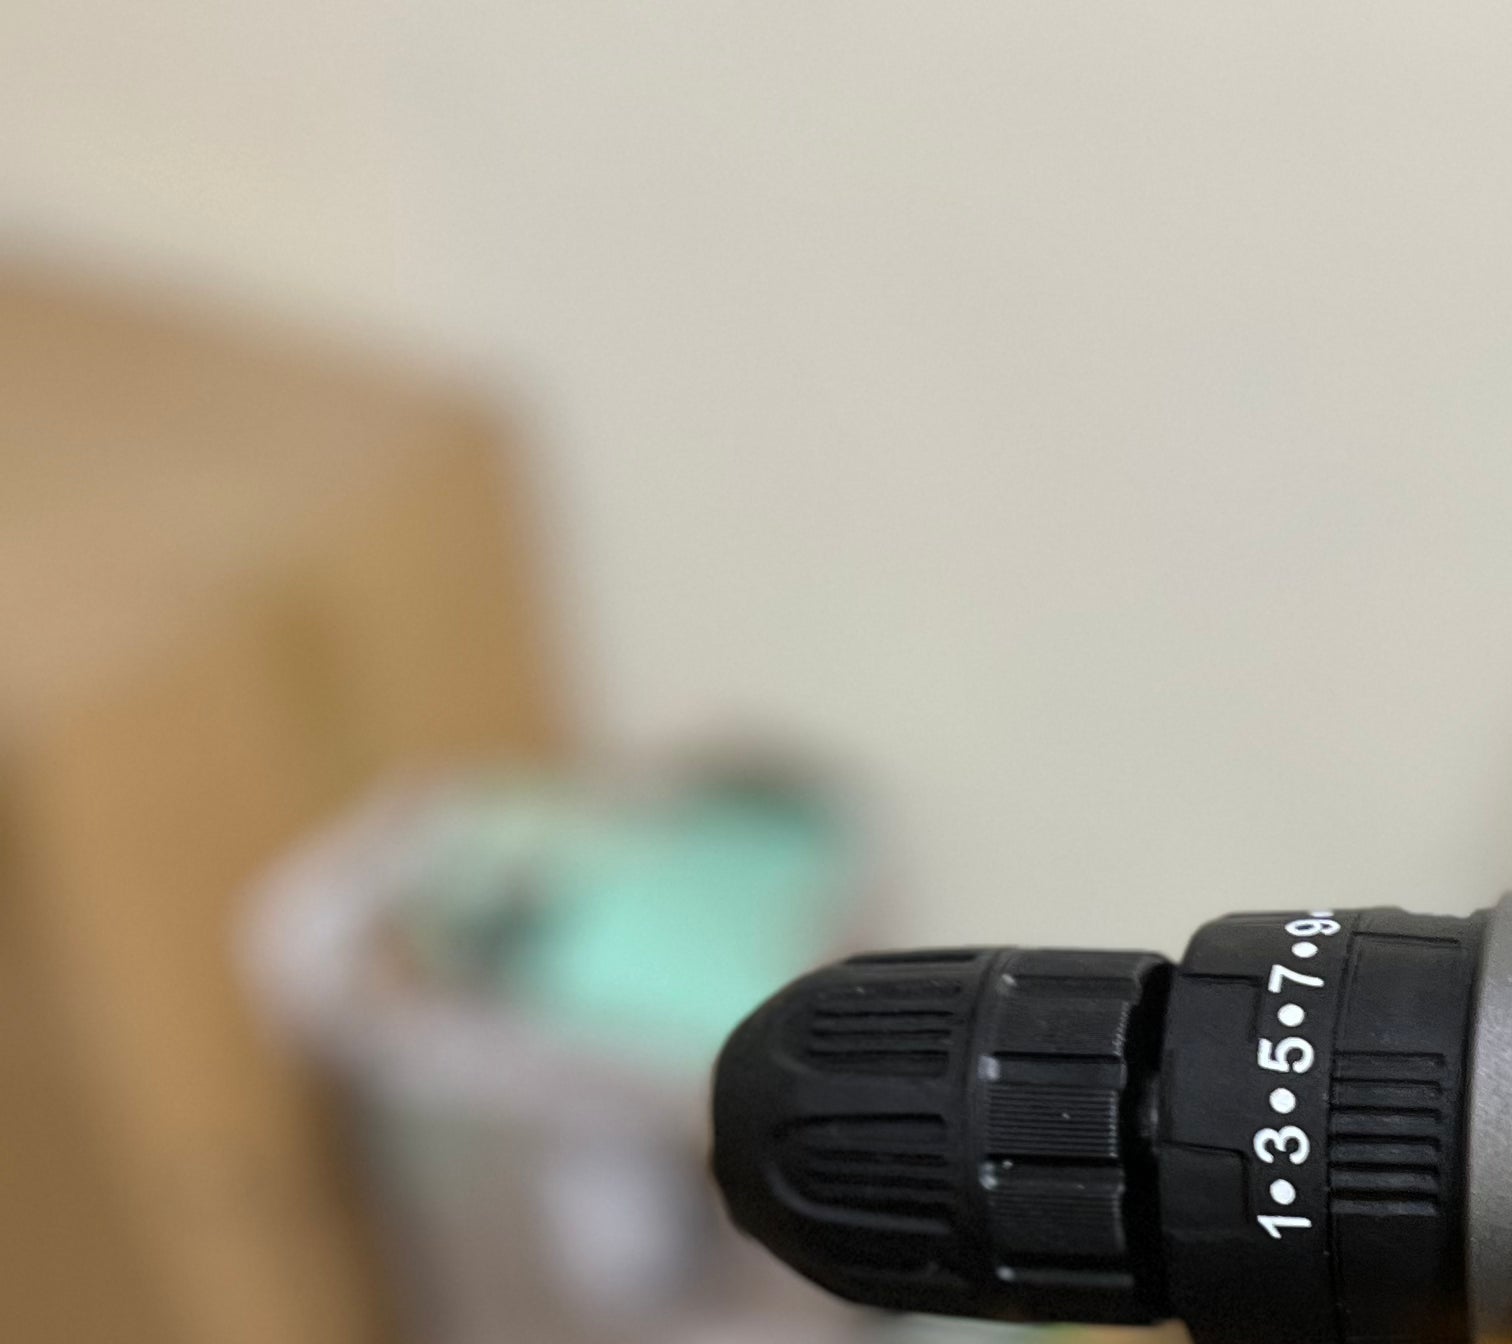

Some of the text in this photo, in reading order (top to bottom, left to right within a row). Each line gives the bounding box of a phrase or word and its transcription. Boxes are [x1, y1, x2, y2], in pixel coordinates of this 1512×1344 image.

[1267, 964, 1325, 994] 7
[1257, 1035, 1315, 1074] 5
[1253, 1125, 1311, 1165] 3
